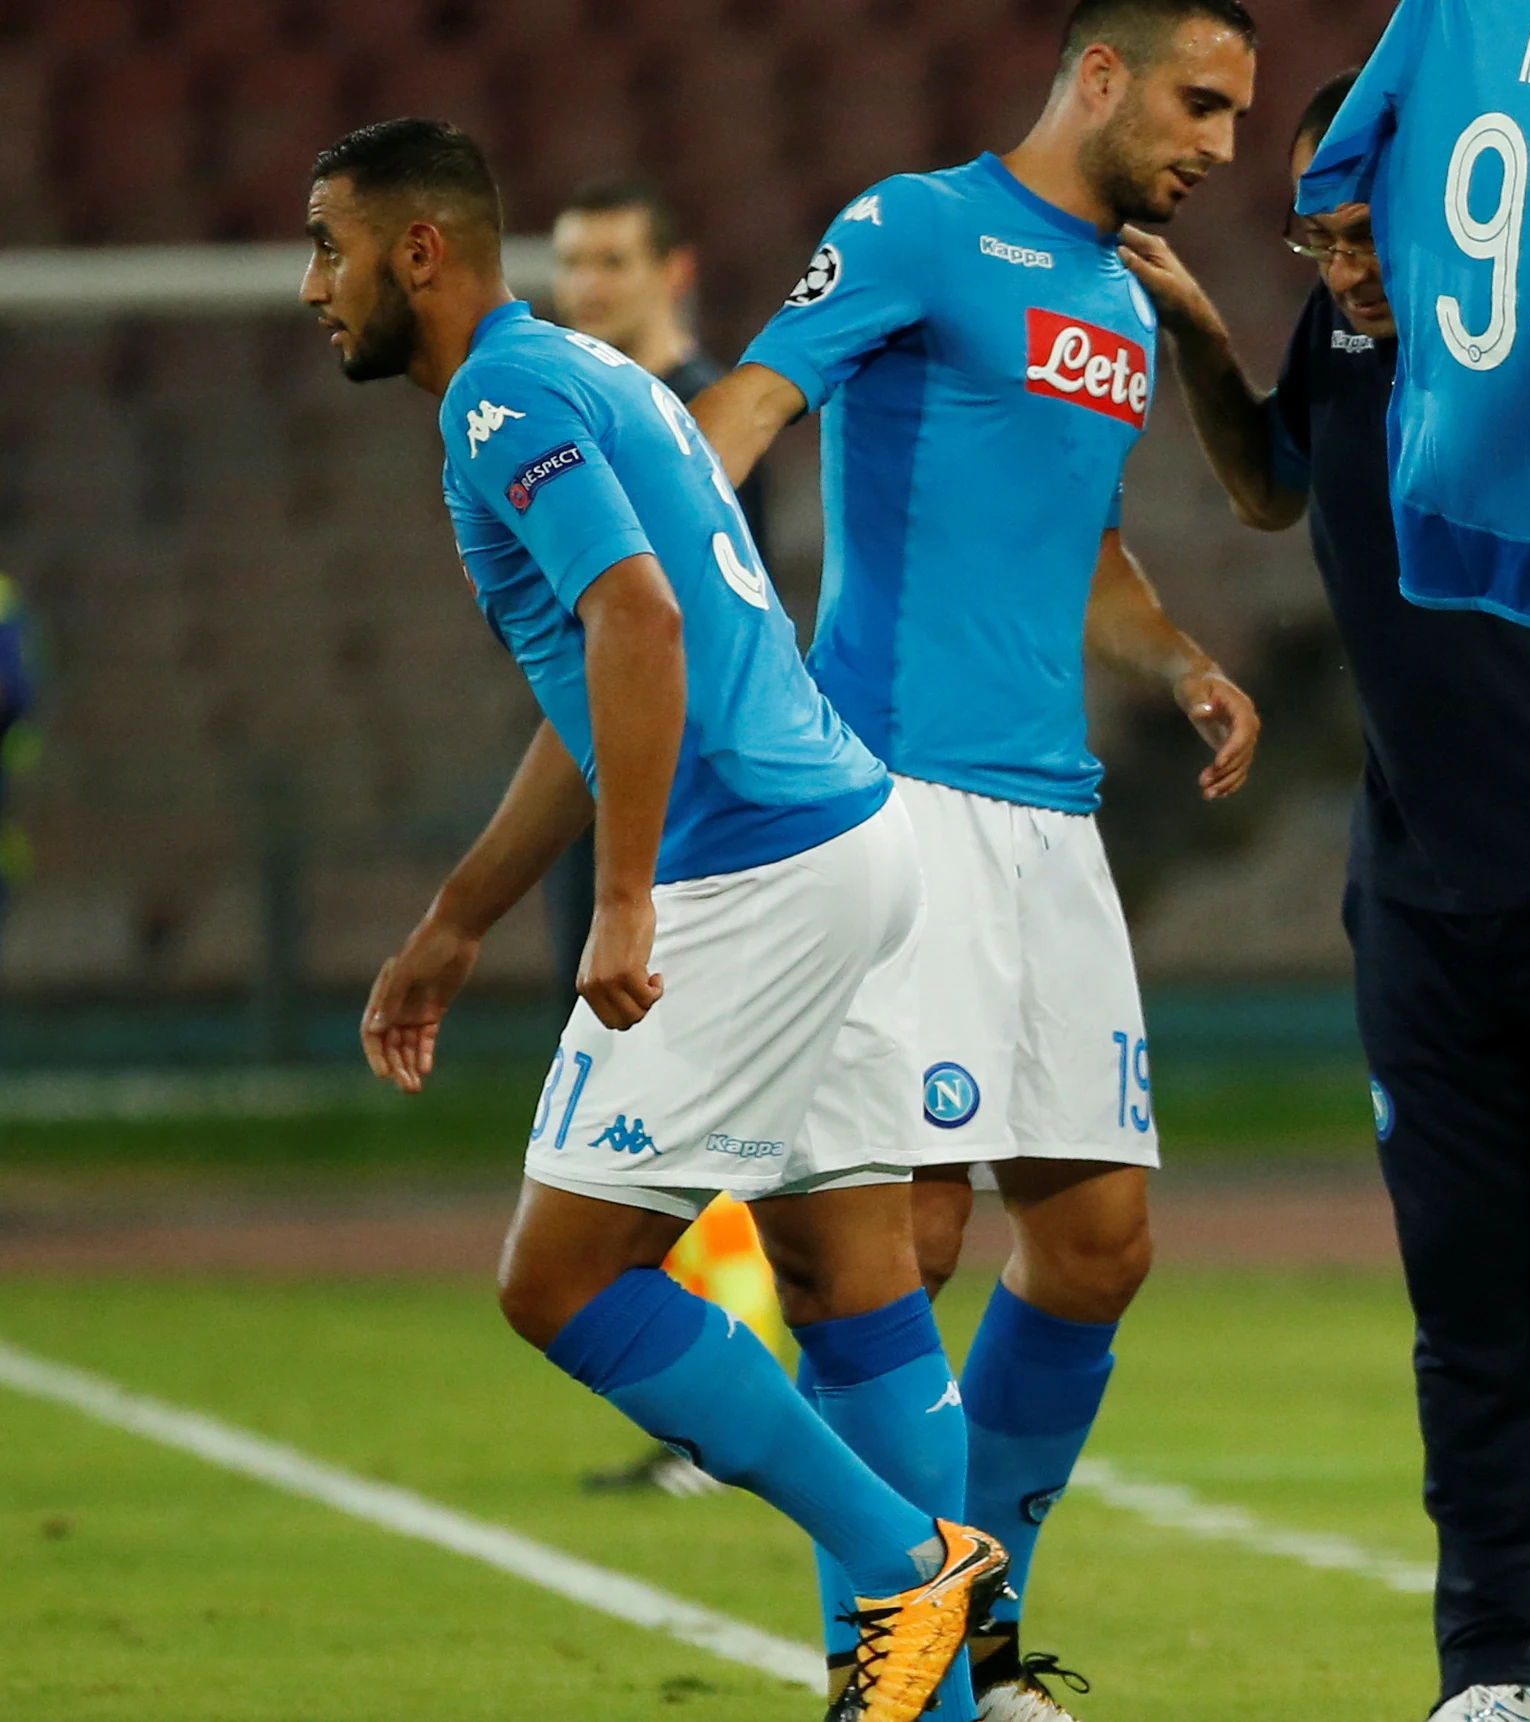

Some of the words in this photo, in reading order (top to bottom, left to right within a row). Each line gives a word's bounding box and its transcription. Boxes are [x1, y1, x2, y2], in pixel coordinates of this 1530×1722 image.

[980, 235, 1054, 269] Kappa
[1026, 326, 1147, 414] Lete
[521, 447, 580, 491] RESPECT
[934, 1078, 963, 1112] N
[1113, 1031, 1149, 1133] 19
[706, 1133, 784, 1158] Kappa
